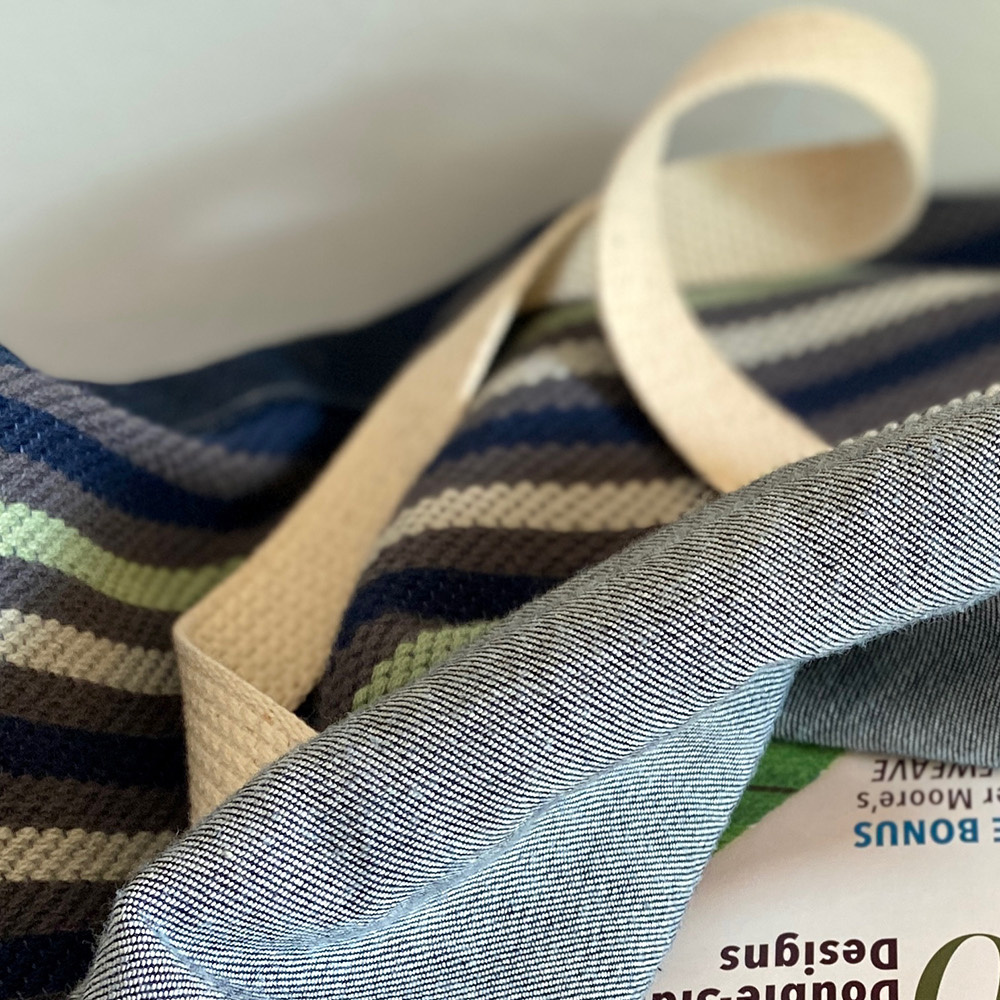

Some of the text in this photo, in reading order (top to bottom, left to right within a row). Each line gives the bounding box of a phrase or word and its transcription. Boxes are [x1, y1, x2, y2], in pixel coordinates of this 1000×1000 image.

[857, 788, 973, 813] Moore's
[853, 818, 980, 848] BONUS
[719, 932, 898, 976] Designs
